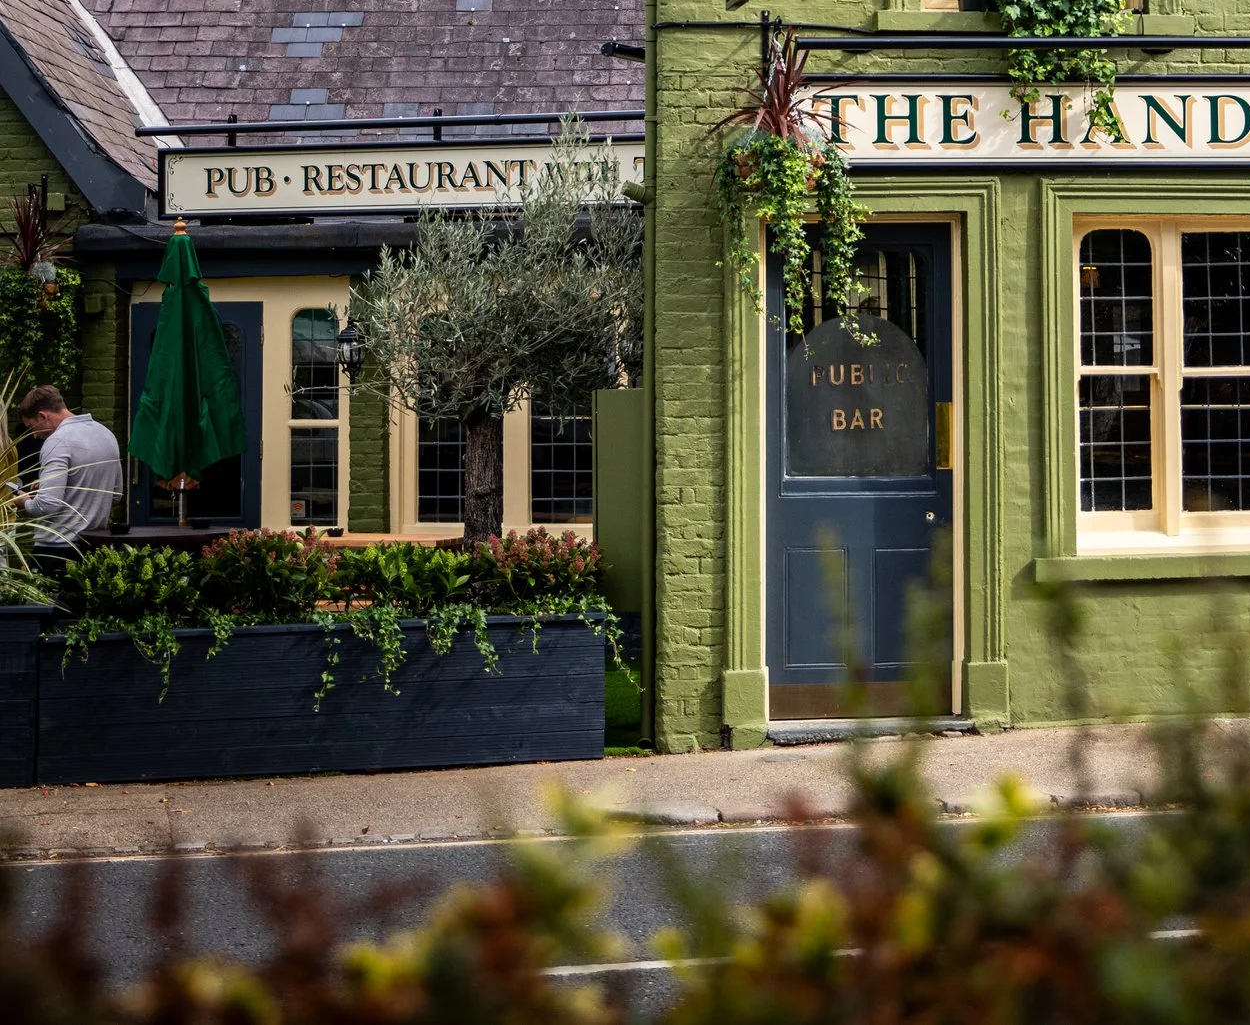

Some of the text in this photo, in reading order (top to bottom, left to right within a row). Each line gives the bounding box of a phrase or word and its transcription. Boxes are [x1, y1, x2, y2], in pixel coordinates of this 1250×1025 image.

[813, 93, 981, 151] THE
[203, 165, 278, 199] PUB
[301, 159, 537, 196] RESTAURANT
[832, 409, 883, 431] BAR
